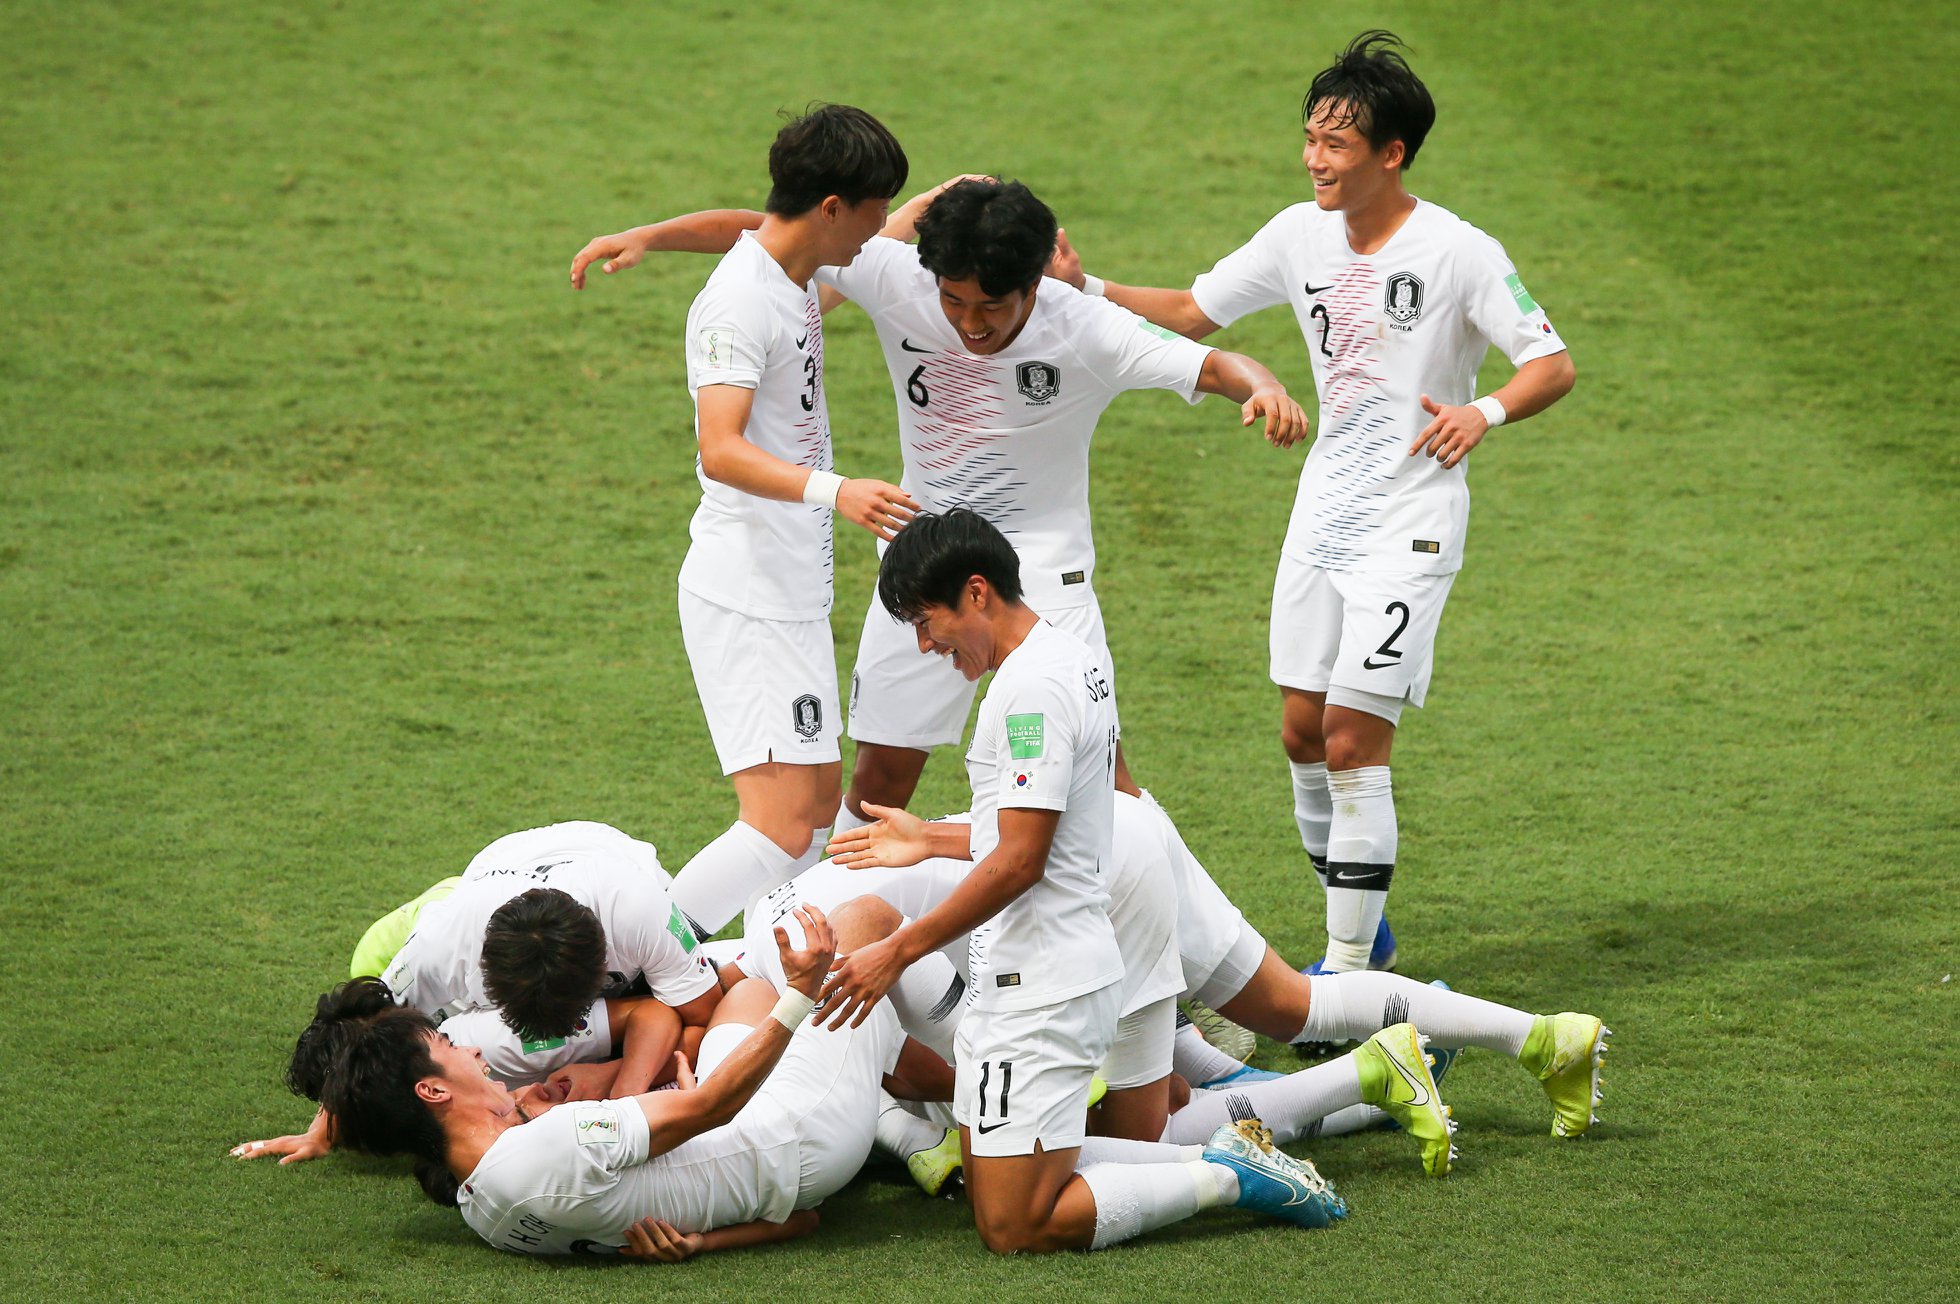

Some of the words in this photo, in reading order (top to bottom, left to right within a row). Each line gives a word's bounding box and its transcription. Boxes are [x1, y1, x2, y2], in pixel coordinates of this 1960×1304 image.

[1311, 304, 1333, 358] 2
[1389, 323, 1413, 332] KOREA
[801, 355, 816, 412] 3
[908, 365, 929, 408] 6
[1376, 602, 1410, 658] 2
[1009, 725, 1041, 733] LIVING
[979, 1061, 1013, 1117] 11
